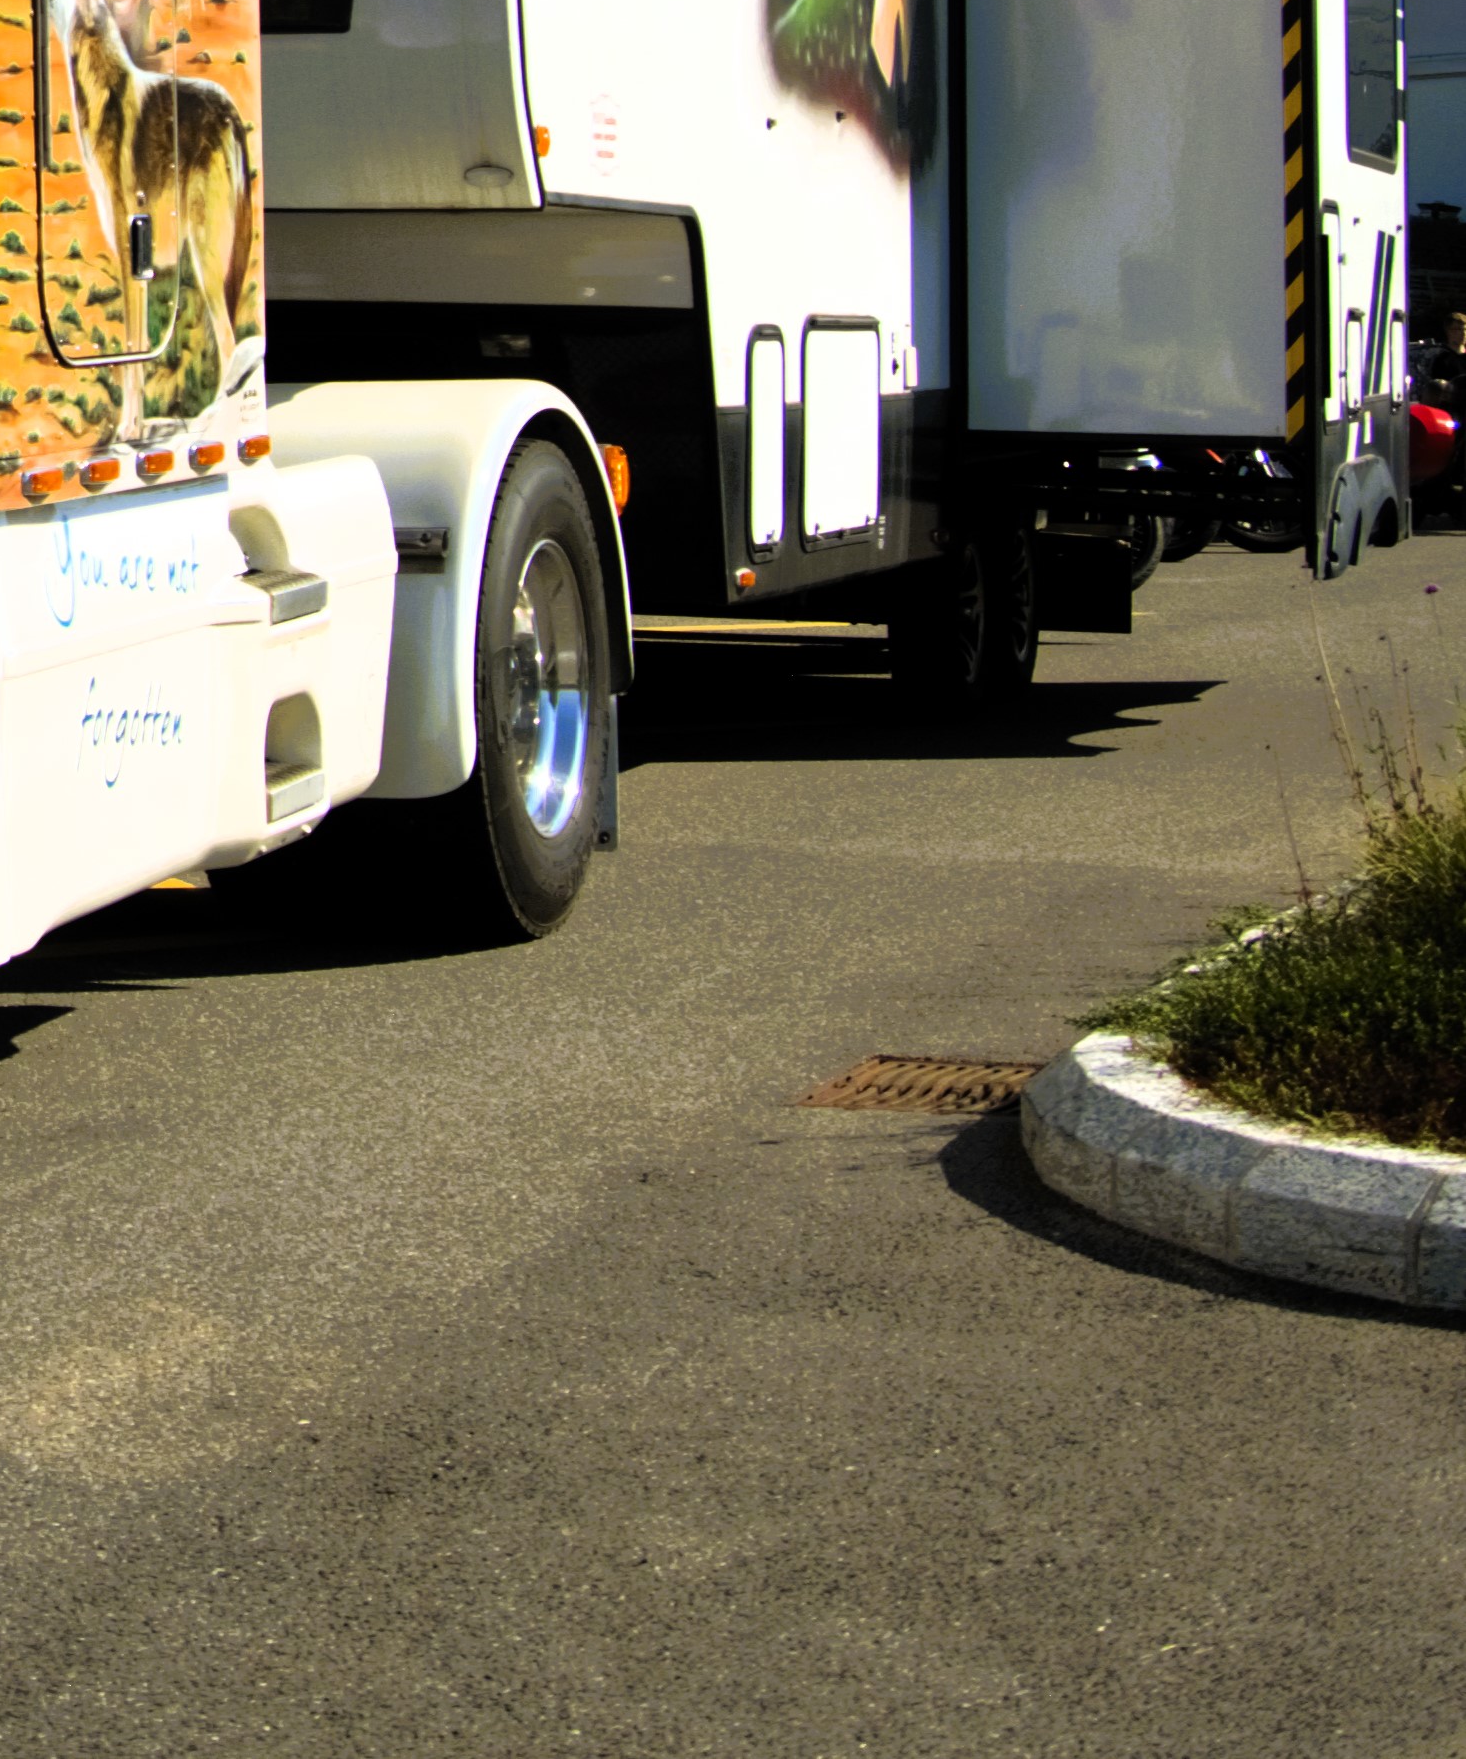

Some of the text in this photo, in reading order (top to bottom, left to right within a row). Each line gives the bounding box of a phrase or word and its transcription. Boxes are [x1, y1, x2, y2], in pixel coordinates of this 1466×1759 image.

[45, 514, 200, 628] You are not
[77, 675, 182, 788] forgotten
